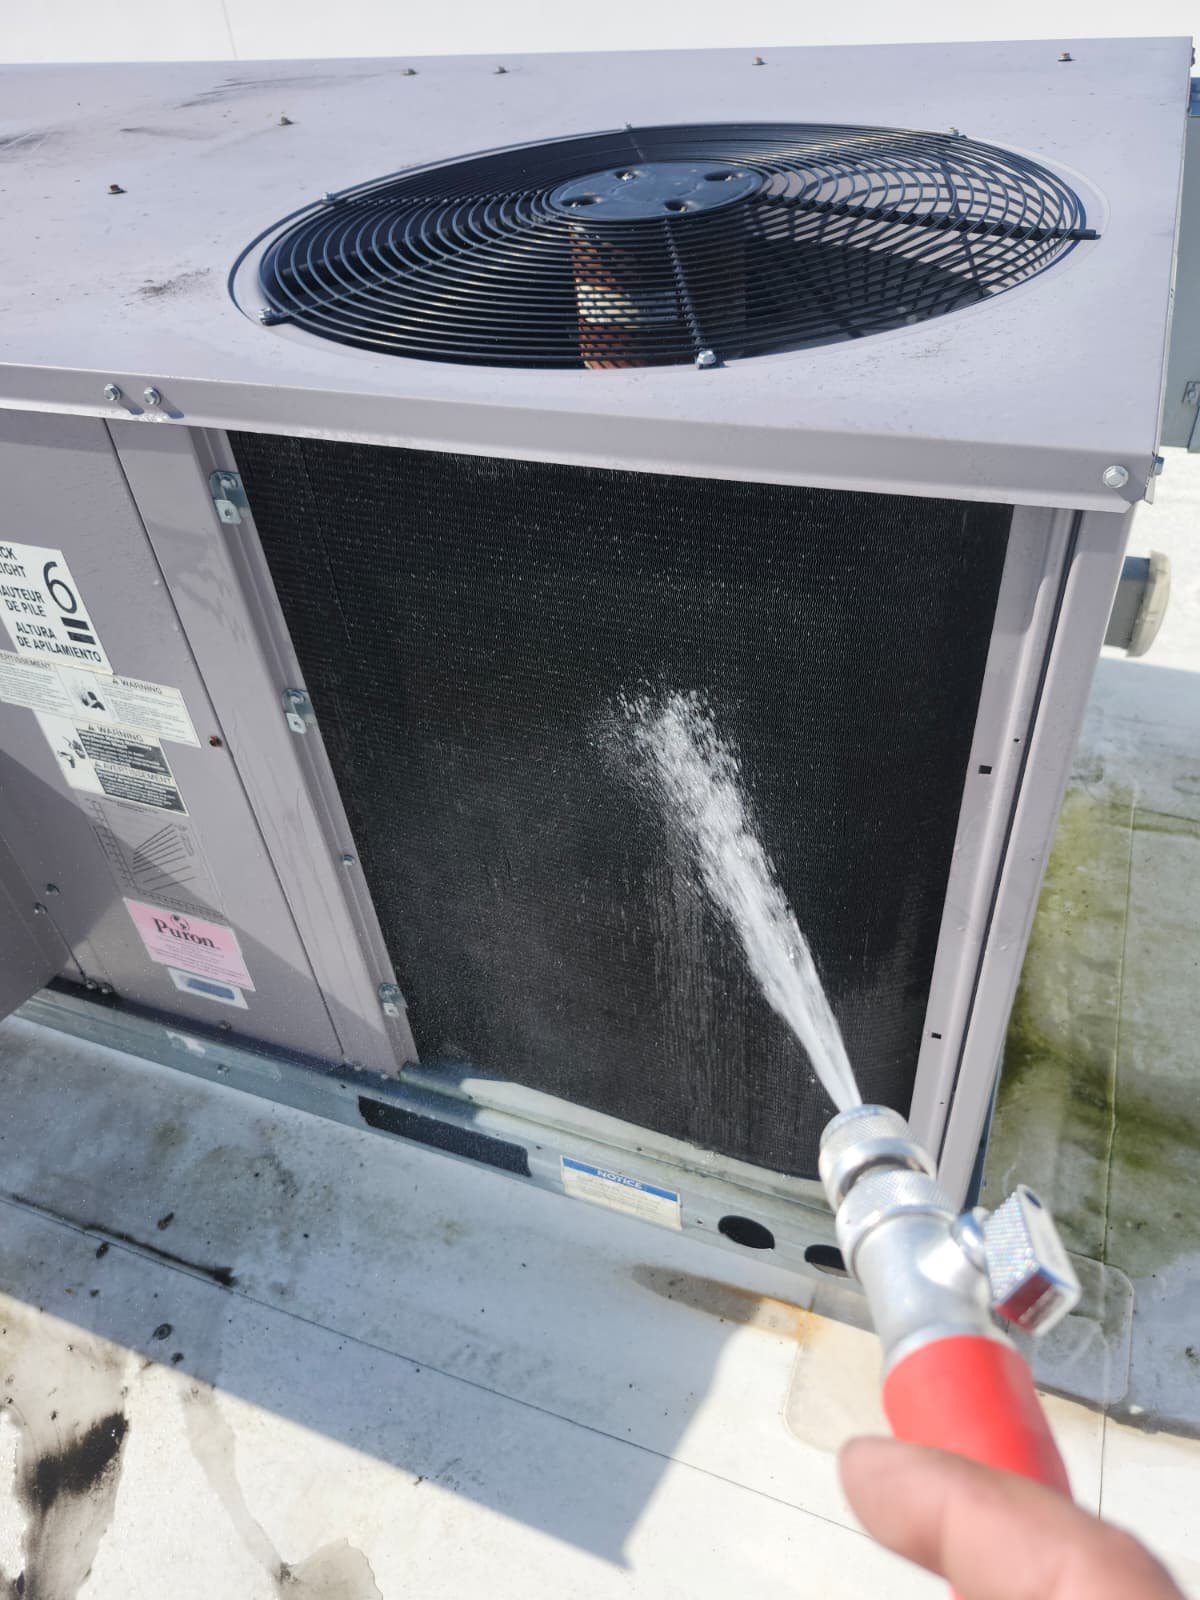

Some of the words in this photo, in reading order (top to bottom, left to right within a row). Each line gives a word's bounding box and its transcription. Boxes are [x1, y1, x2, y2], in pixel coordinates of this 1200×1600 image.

[0, 546, 17, 560] CK
[0, 562, 26, 578] IGHT
[43, 561, 77, 614] 6
[5, 599, 21, 612] DE
[21, 602, 47, 617] PILE
[16, 621, 57, 640] ALTURA
[16, 636, 32, 648] DE
[33, 638, 102, 662] APILAMIENTO
[152, 917, 215, 948] Puron
[597, 1170, 643, 1189] NOTICE
